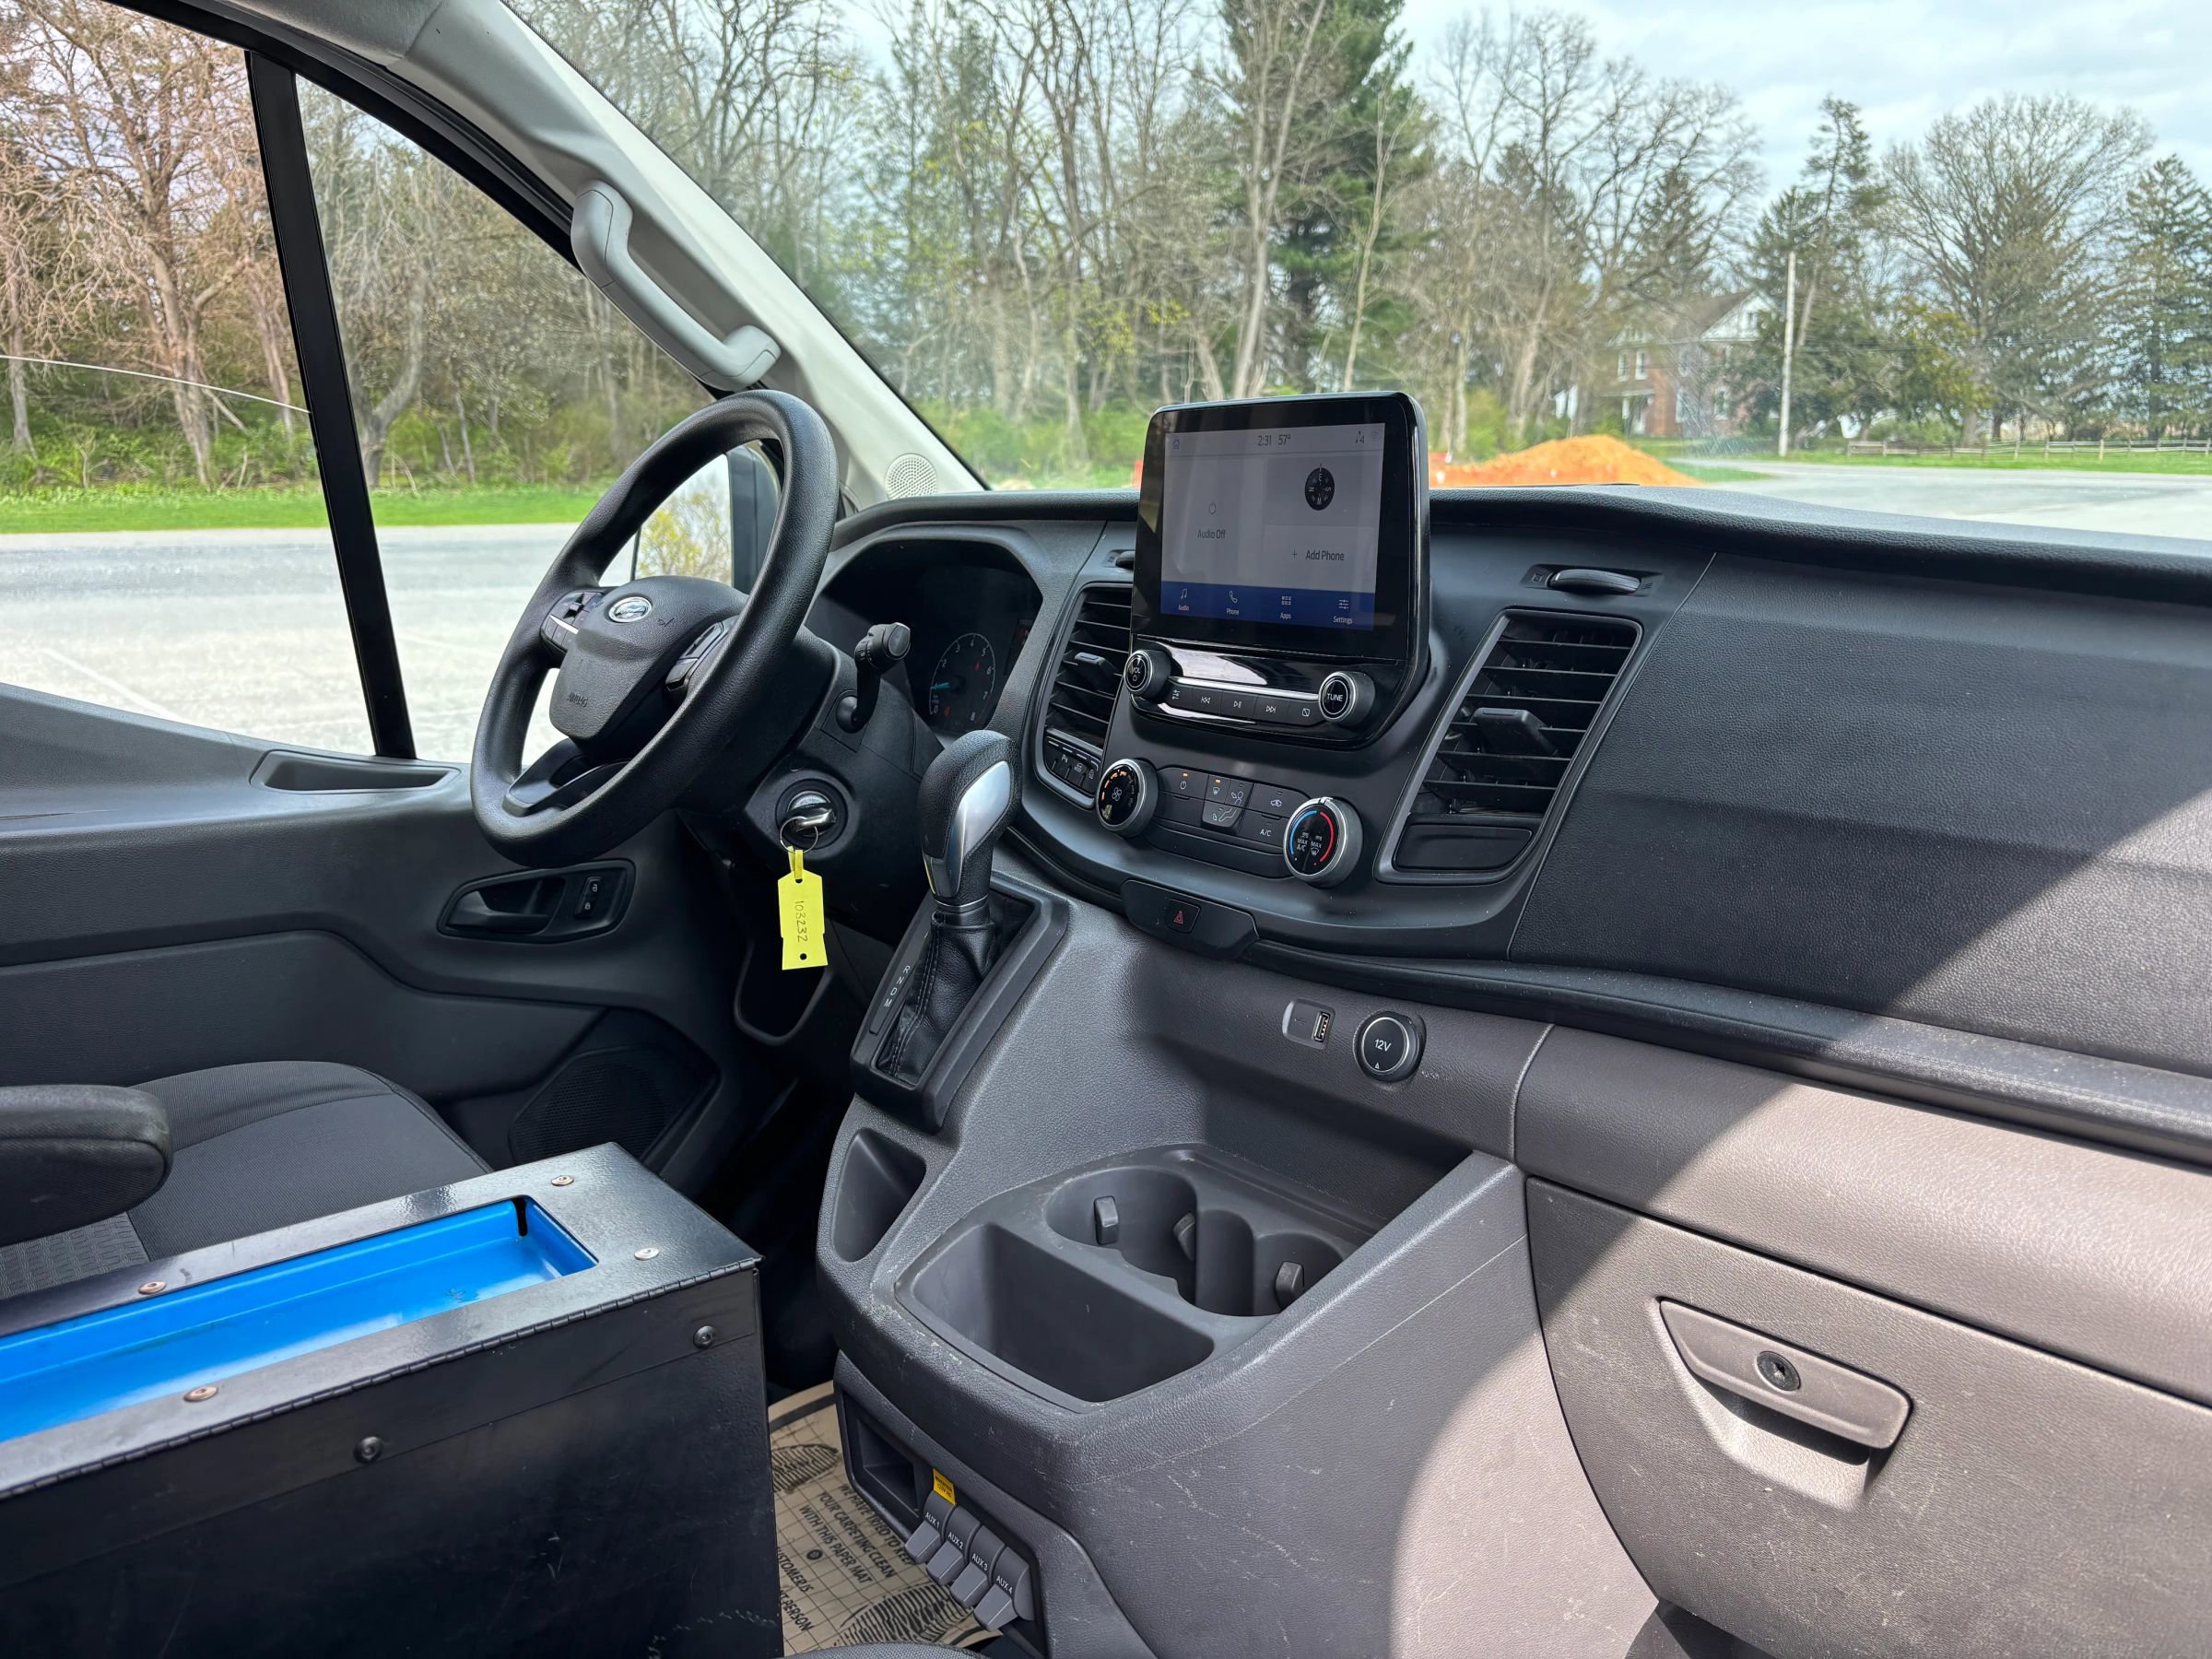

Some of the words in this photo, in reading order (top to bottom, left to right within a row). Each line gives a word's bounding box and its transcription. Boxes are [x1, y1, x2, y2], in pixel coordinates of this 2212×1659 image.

[1257, 435, 1272, 446] 2:31
[1197, 529, 1216, 539] Audio
[1216, 529, 1227, 539] Off
[1305, 549, 1320, 560] Add
[1321, 550, 1345, 561] Phone
[1226, 607, 1240, 616] Phone
[1279, 612, 1292, 620] Apps
[1333, 616, 1353, 625] Settings
[1327, 693, 1344, 702] TUNE
[1259, 829, 1272, 837] A/C
[1297, 843, 1307, 852] A/C
[794, 900, 809, 943] 103232
[903, 965, 911, 974] R
[896, 976, 905, 984] N
[889, 987, 898, 995] D
[1374, 1039, 1392, 1052] 12V
[924, 1512, 937, 1524] AUX
[816, 1491, 840, 1516] YOUR
[833, 1512, 877, 1554] CARPETING
[868, 1551, 896, 1579] CLEAN
[884, 1533, 900, 1547] TO
[947, 1532, 960, 1546] AUX
[799, 1504, 825, 1527] WITH
[816, 1524, 837, 1545] THIS
[829, 1542, 857, 1568] PAPER
[848, 1564, 874, 1584] MAT
[971, 1552, 984, 1567] AUX
[996, 1575, 1008, 1589] AUX
[782, 1599, 815, 1631] PERSON
